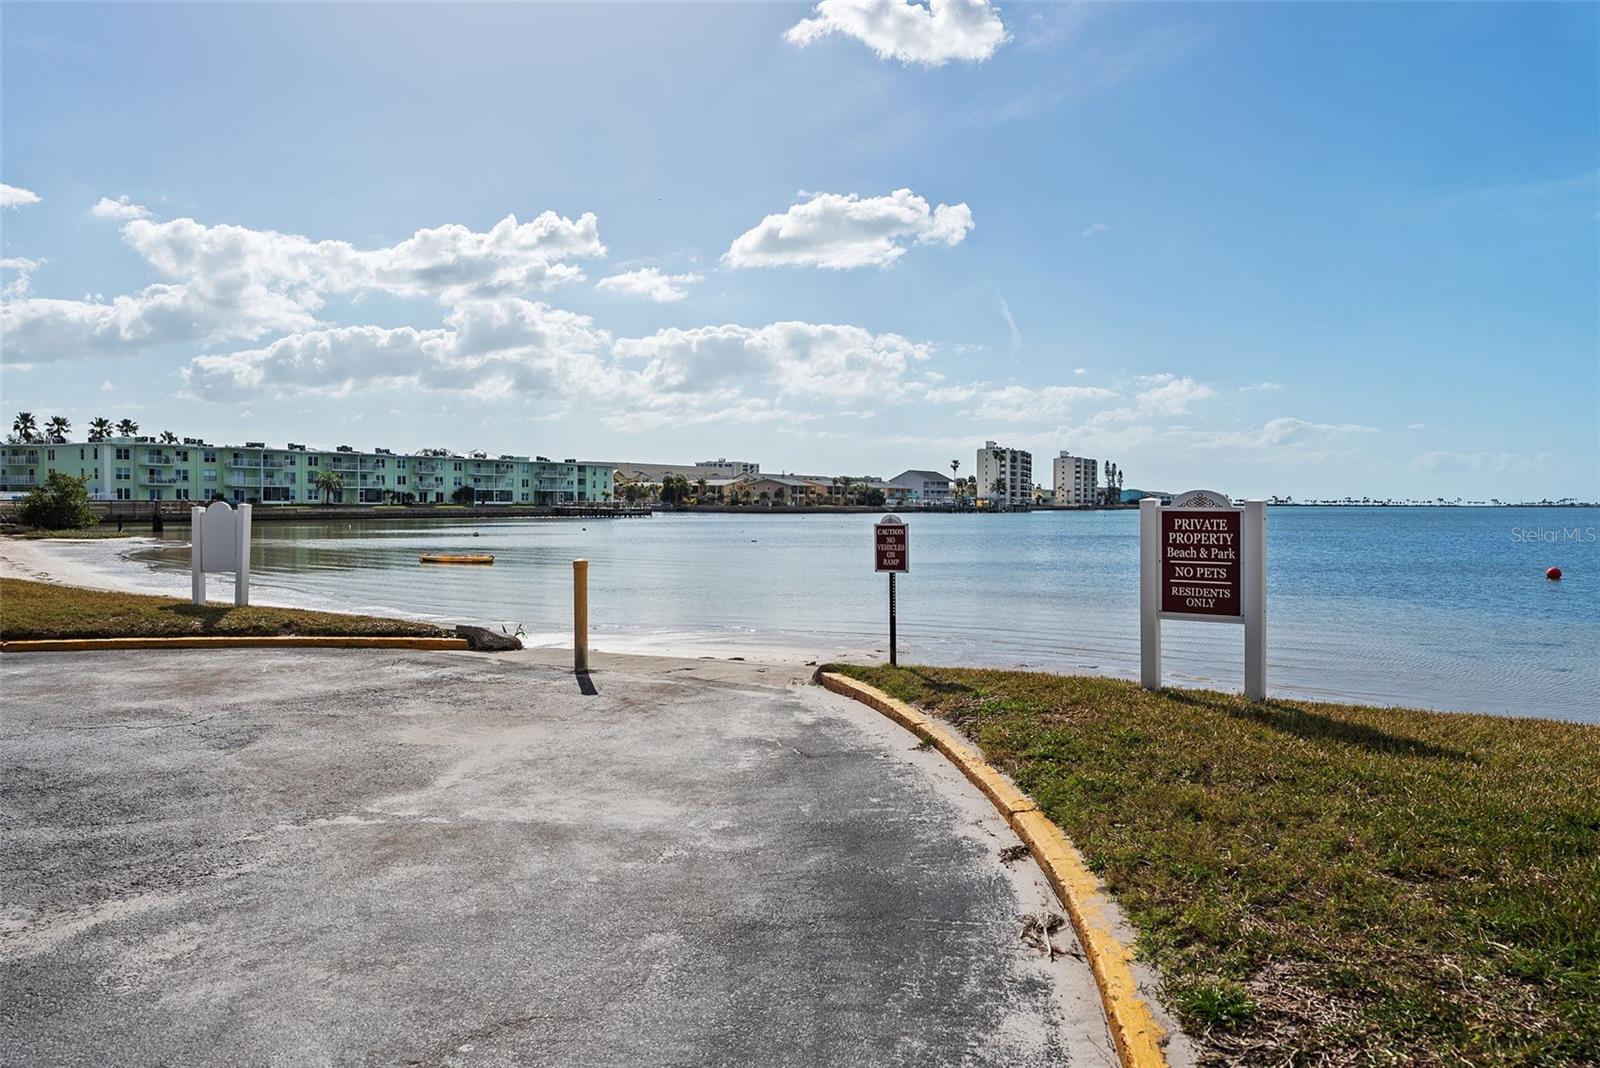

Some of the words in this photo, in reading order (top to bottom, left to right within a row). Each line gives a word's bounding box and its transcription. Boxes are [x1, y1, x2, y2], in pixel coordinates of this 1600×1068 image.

[1174, 518, 1228, 531] PRIVATE
[1168, 532, 1234, 545] PROPERTY
[1167, 546, 1197, 558] Beach
[1199, 547, 1208, 558] &
[1211, 547, 1235, 559] Park
[883, 558, 900, 566] RAMP
[1175, 566, 1194, 577] NO
[1196, 567, 1227, 578] PETS
[1171, 586, 1231, 598] RESIDENTS
[1186, 598, 1215, 608] ONLY
